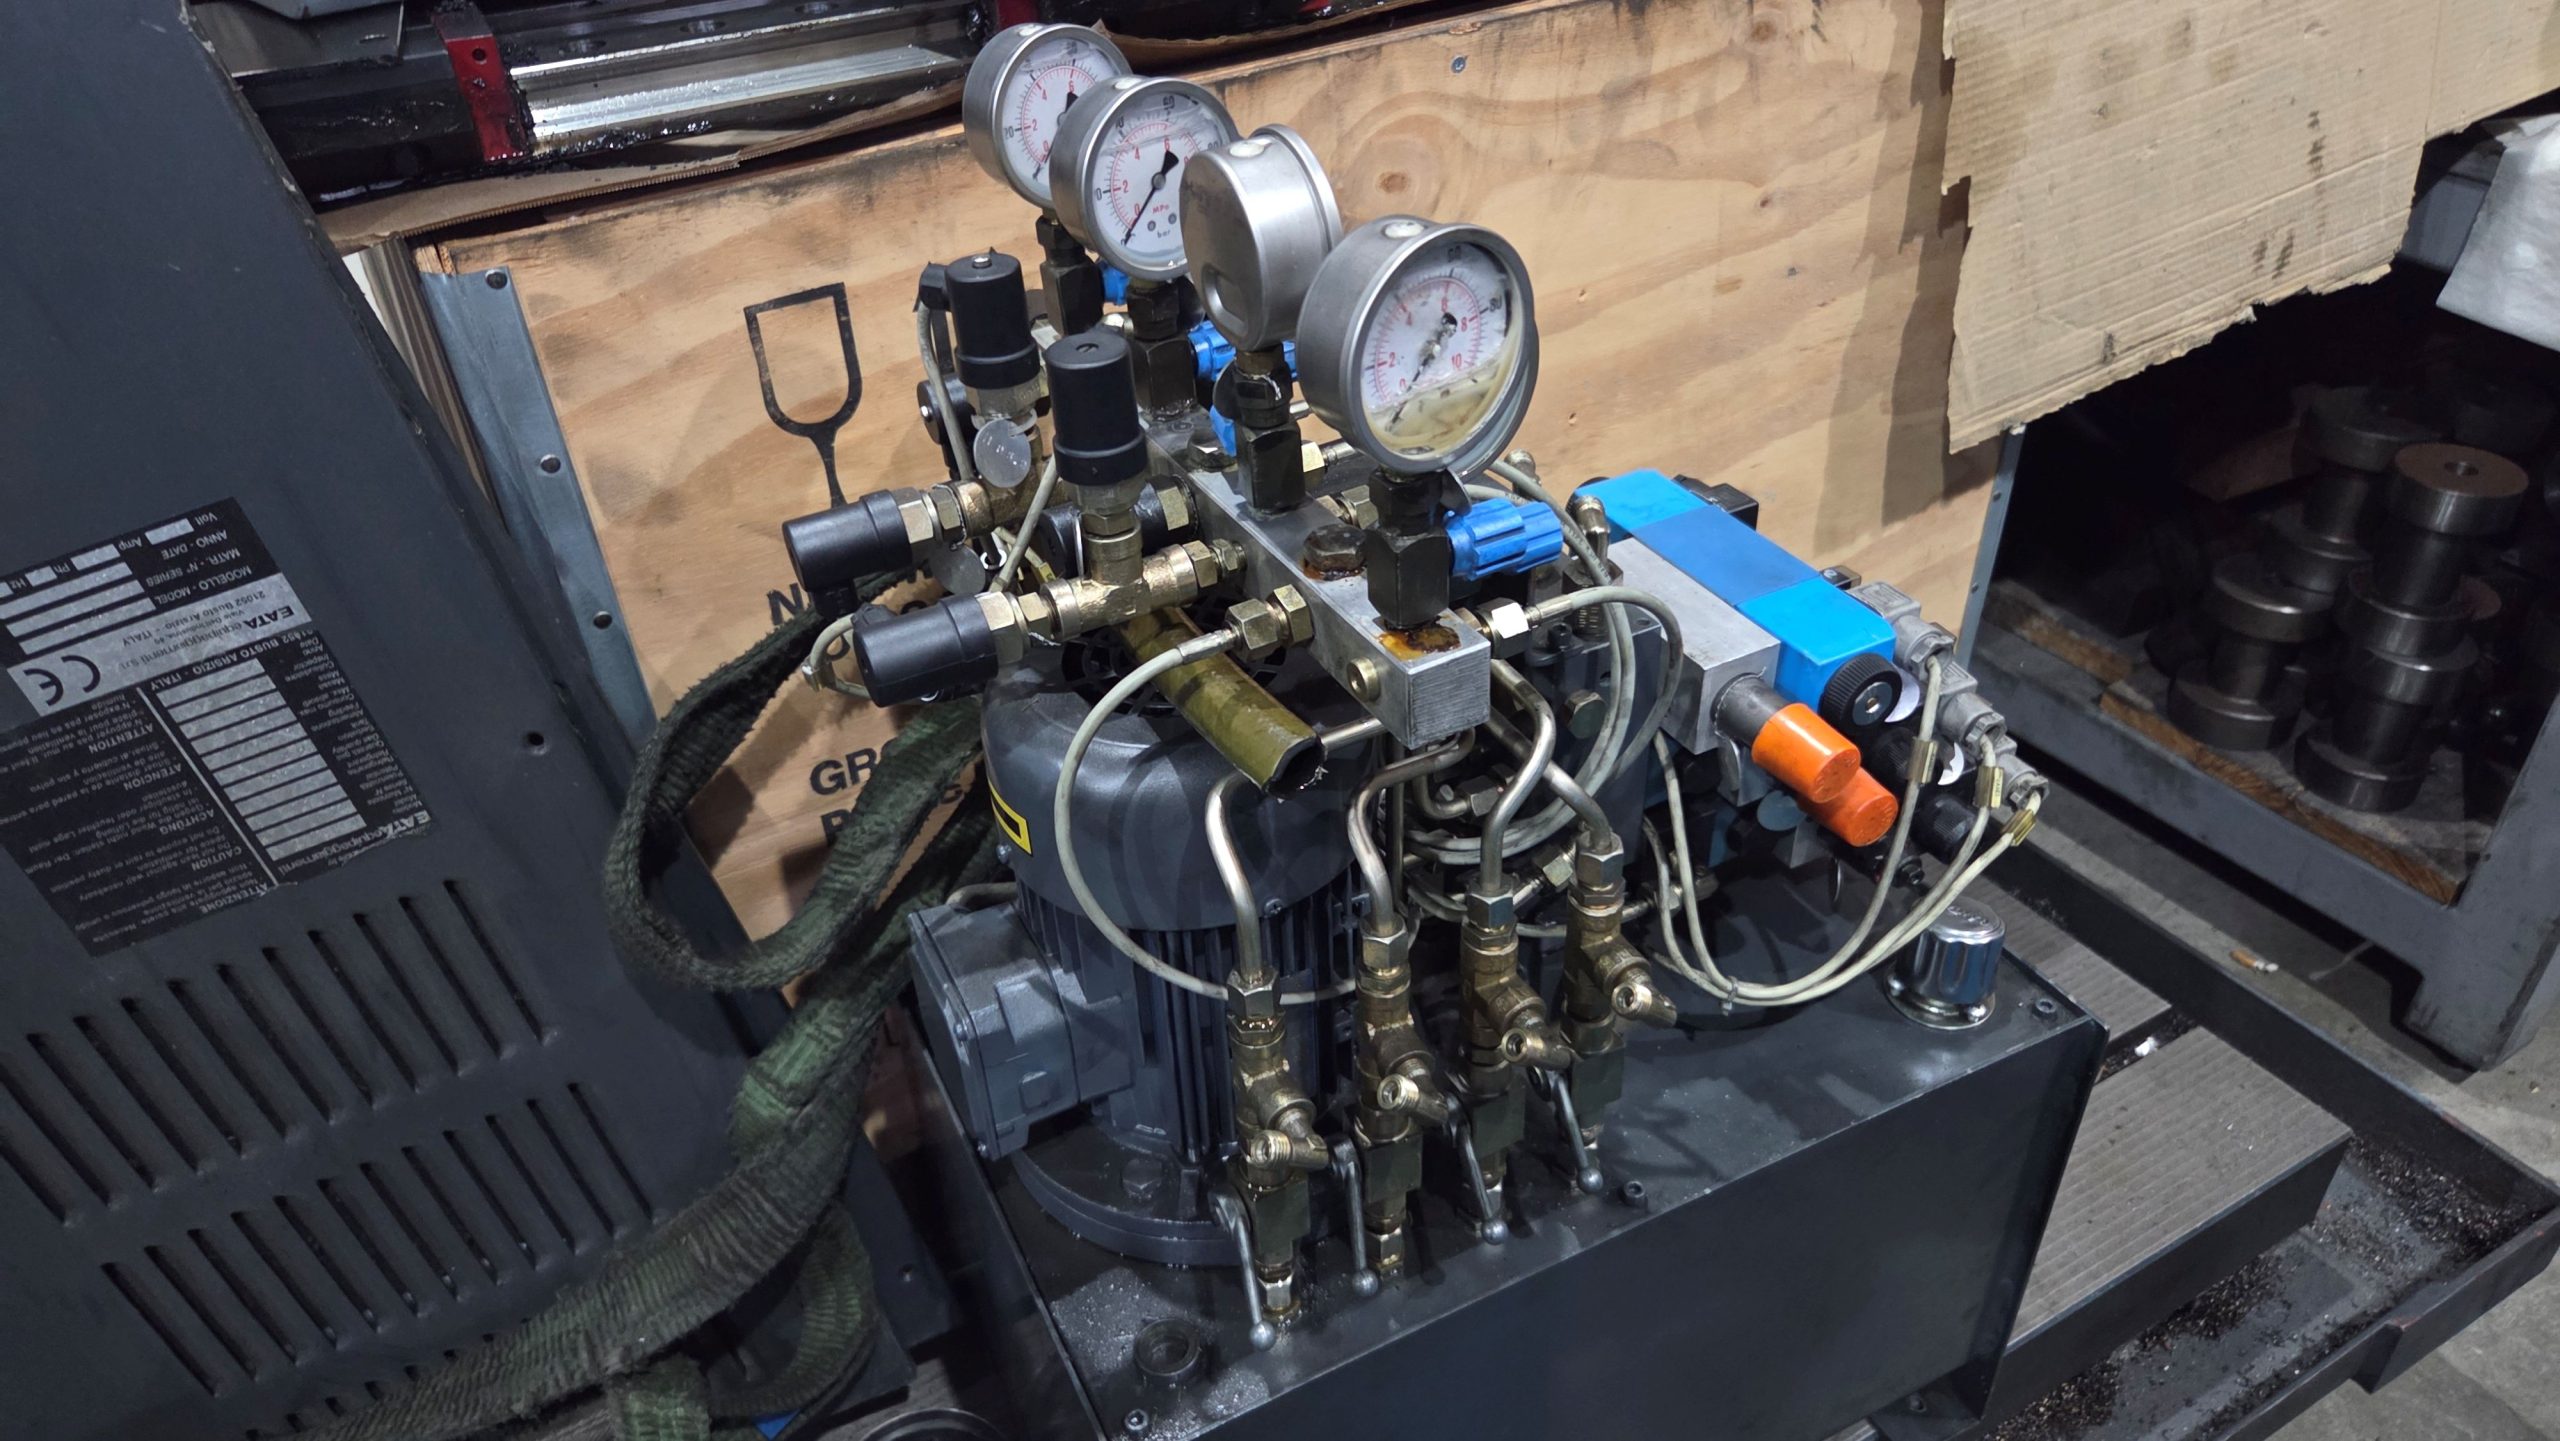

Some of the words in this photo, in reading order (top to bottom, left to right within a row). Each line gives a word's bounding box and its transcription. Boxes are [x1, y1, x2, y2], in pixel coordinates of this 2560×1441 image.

[1068, 80, 1076, 93] 6
[1031, 118, 1039, 132] 2
[1164, 138, 1171, 151] 6
[1133, 149, 1141, 161] 4
[1122, 179, 1130, 194] 2
[1460, 316, 1468, 331] 8
[1388, 352, 1396, 369] 2
[1451, 352, 1463, 369] 10
[193, 511, 219, 526] Volt
[116, 536, 145, 553] Amp
[193, 529, 230, 548] ANNO
[158, 543, 189, 560] DATE
[204, 547, 241, 566] MATR.
[51, 562, 71, 575] Ph
[143, 566, 184, 587] SERIES
[195, 564, 252, 590] MODELLO
[7, 577, 27, 590] Hz
[152, 585, 192, 605] MODEL
[232, 590, 266, 607] 21052
[200, 601, 234, 618] Busto
[241, 605, 295, 631] EATA
[163, 612, 202, 631] Arsizio
[119, 629, 153, 646] ITALY
[138, 620, 243, 664] equipaggiamenti
[238, 638, 280, 658] BUSTO
[191, 653, 239, 675] ARSIZIO
[147, 672, 183, 691] ITALY
[85, 722, 156, 754] ATTENTION
[121, 762, 185, 791] ATENCION
[188, 845, 243, 871] CAUTION
[197, 881, 270, 913] ATTENZIONE
